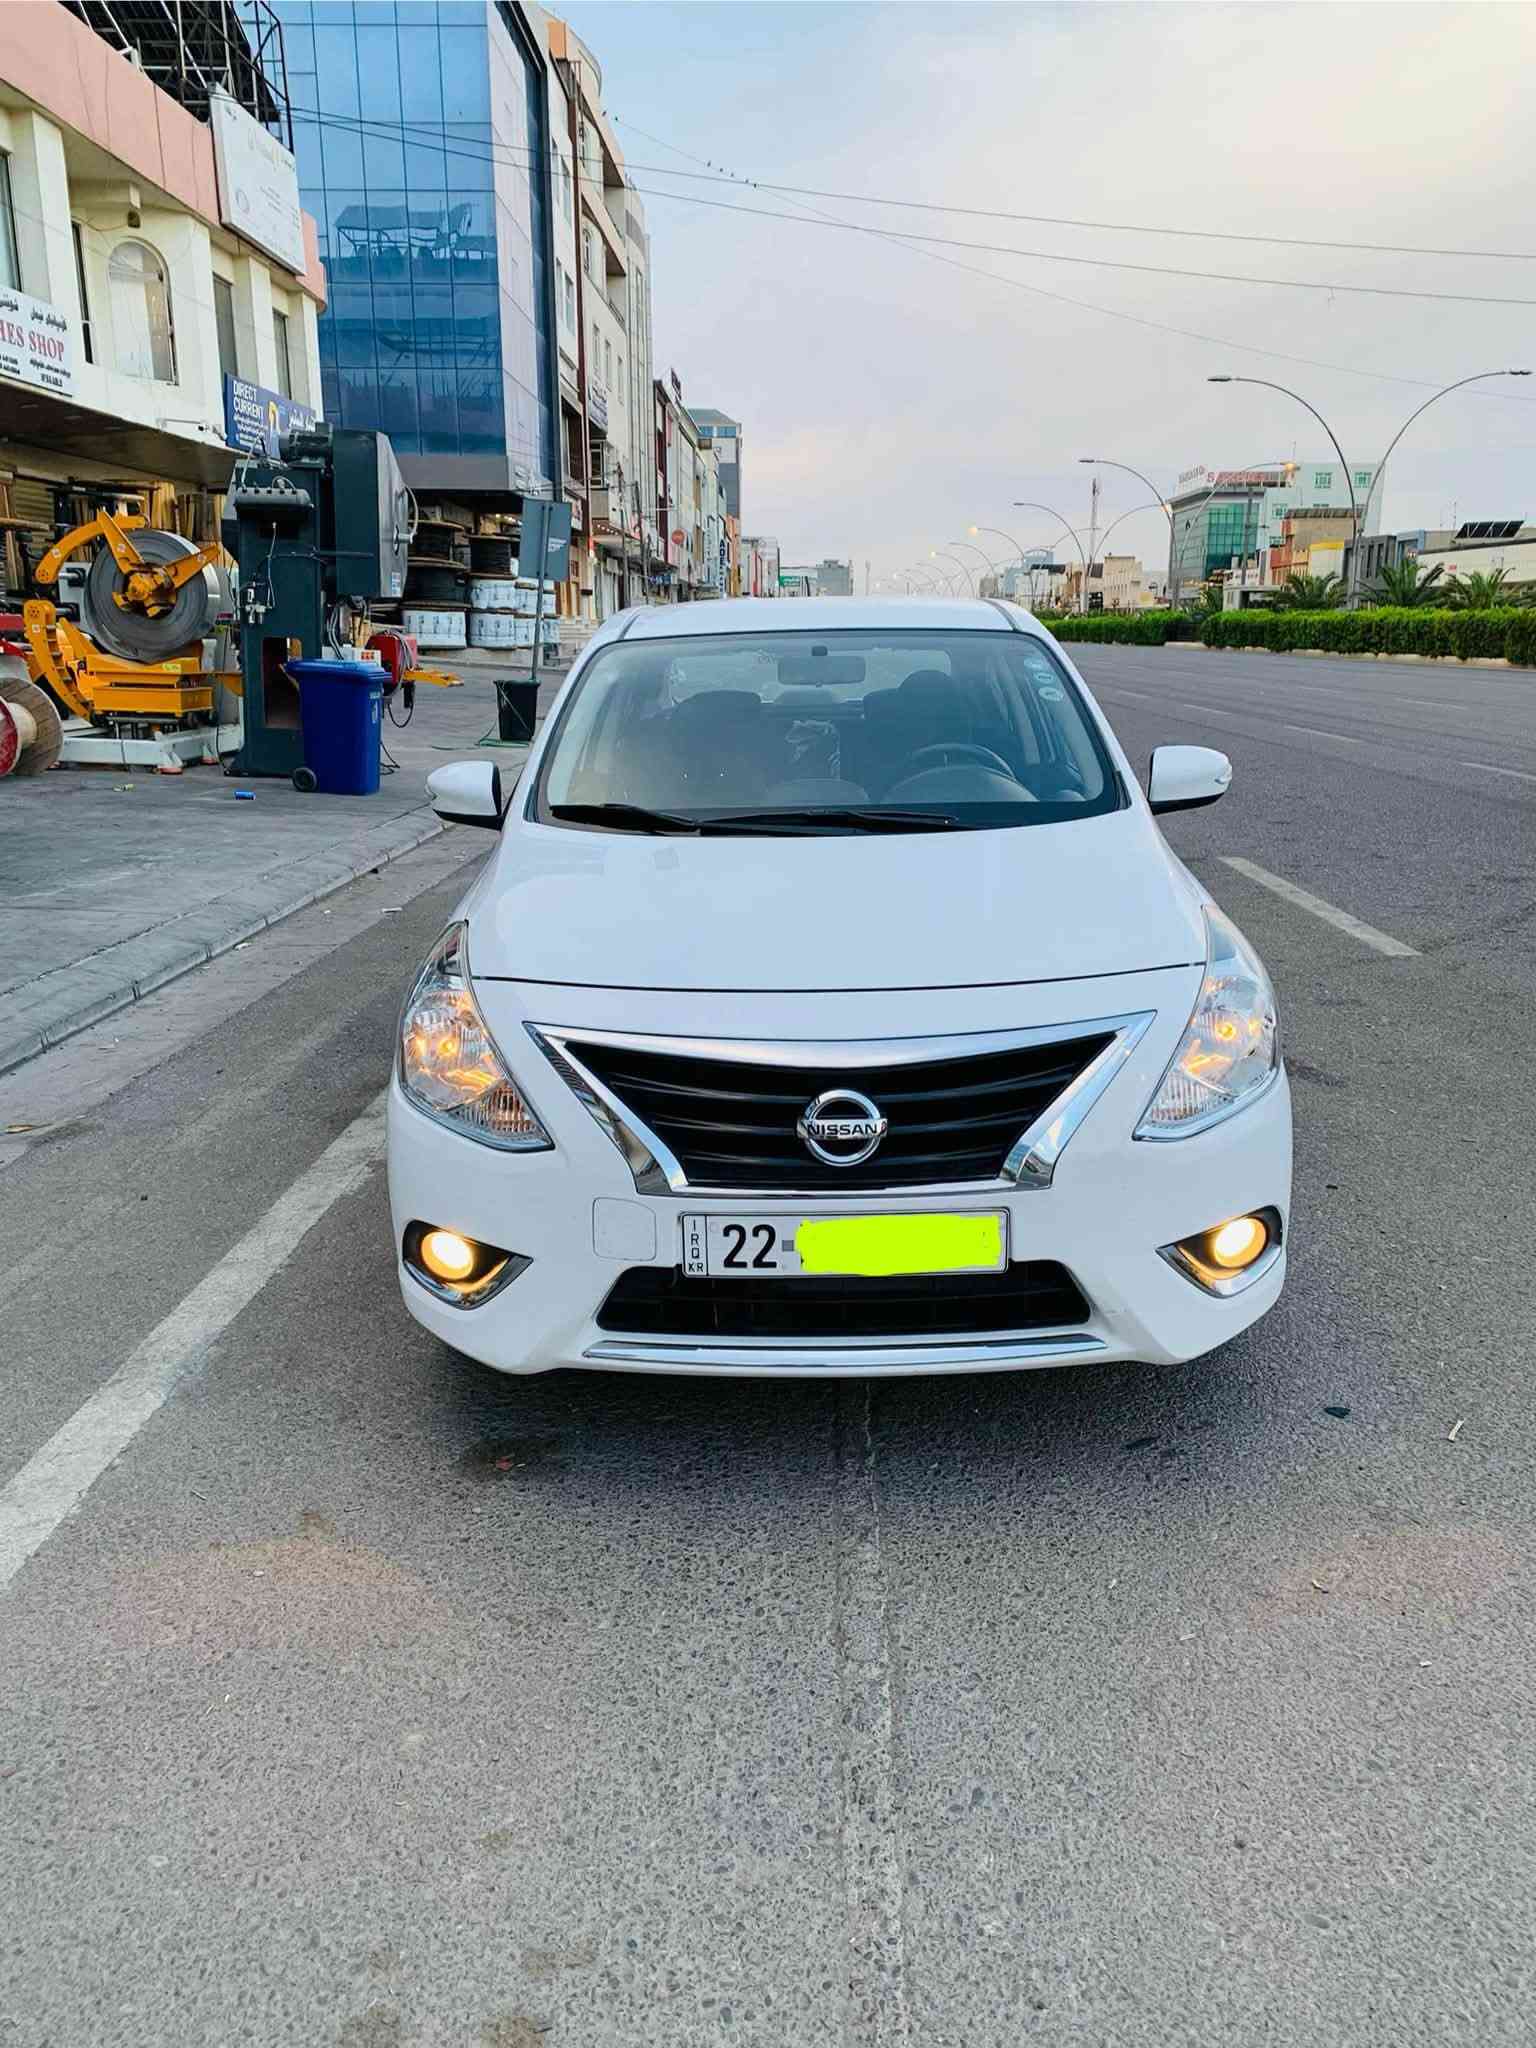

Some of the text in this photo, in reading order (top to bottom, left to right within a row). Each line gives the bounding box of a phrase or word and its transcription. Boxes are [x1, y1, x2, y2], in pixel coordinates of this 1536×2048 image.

[28, 330, 65, 362] SHOP
[233, 380, 257, 402] DIRECT
[233, 396, 264, 427] CURRENT
[807, 1123, 877, 1136] NISSAN
